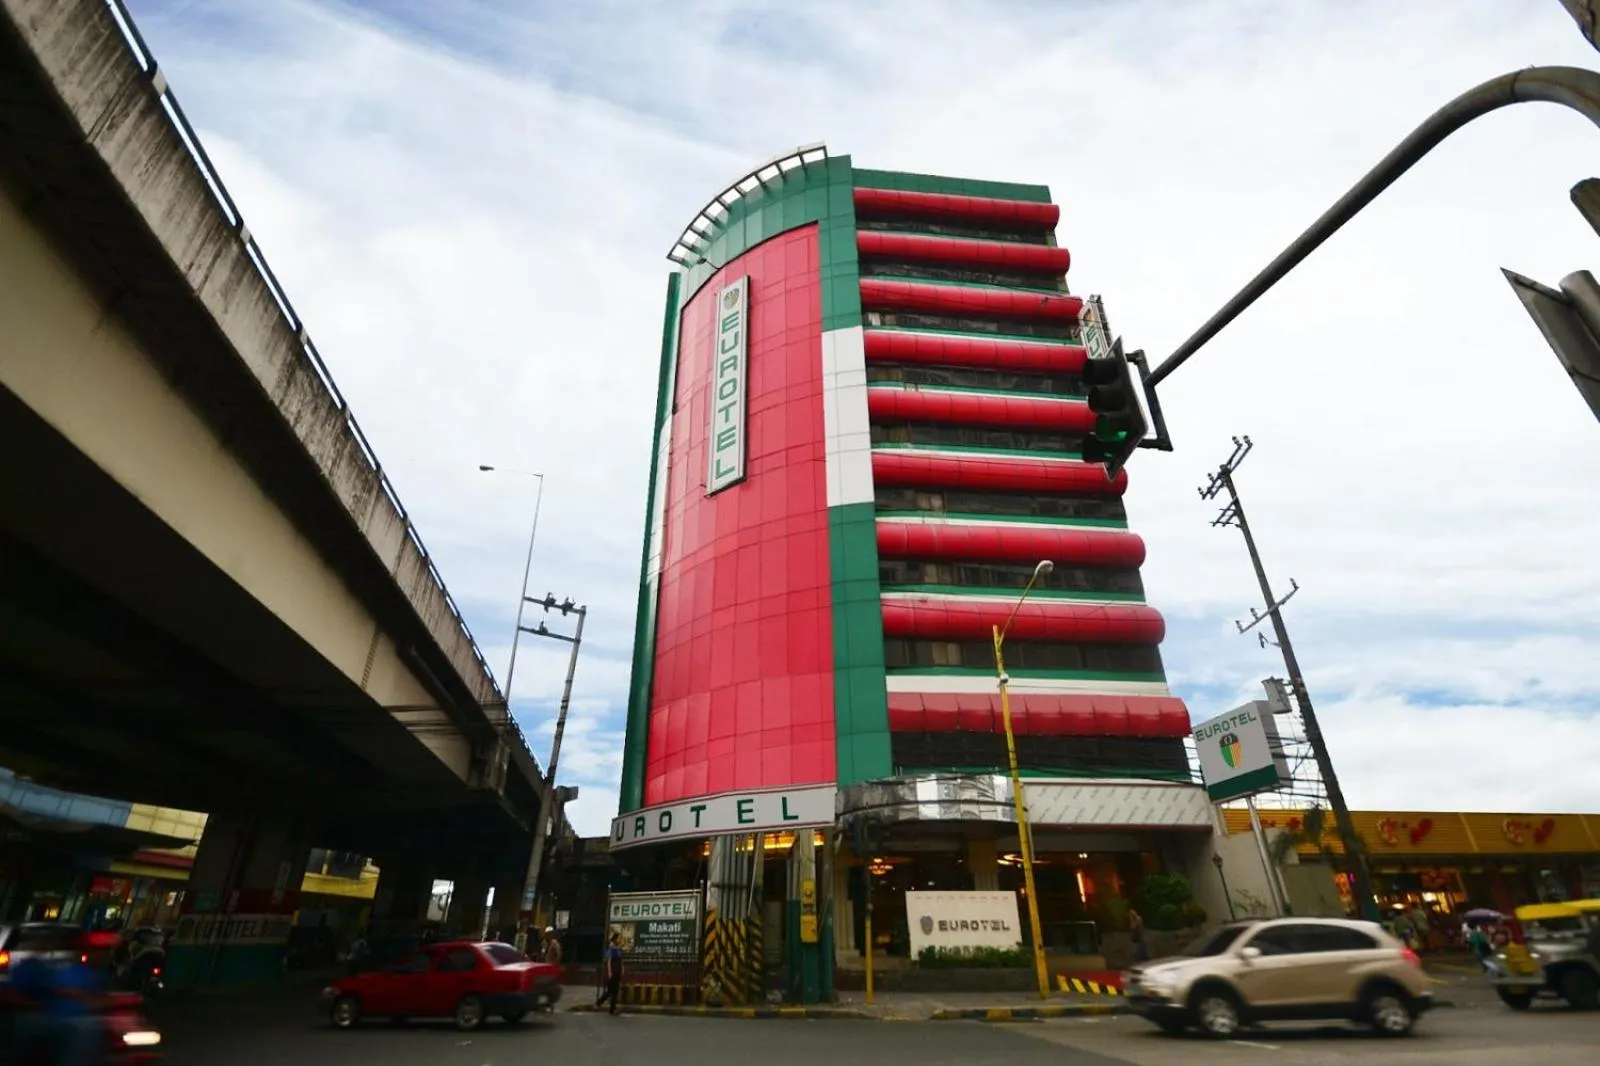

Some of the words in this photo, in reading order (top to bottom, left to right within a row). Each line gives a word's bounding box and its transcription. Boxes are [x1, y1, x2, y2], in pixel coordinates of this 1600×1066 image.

[715, 311, 740, 480] EUROTEL
[1195, 712, 1257, 742] EUROTEL
[615, 796, 799, 842] UROTEL
[621, 903, 693, 916] EUROTEL
[648, 922, 681, 933] Makati
[938, 919, 1010, 932] EUROTEL
